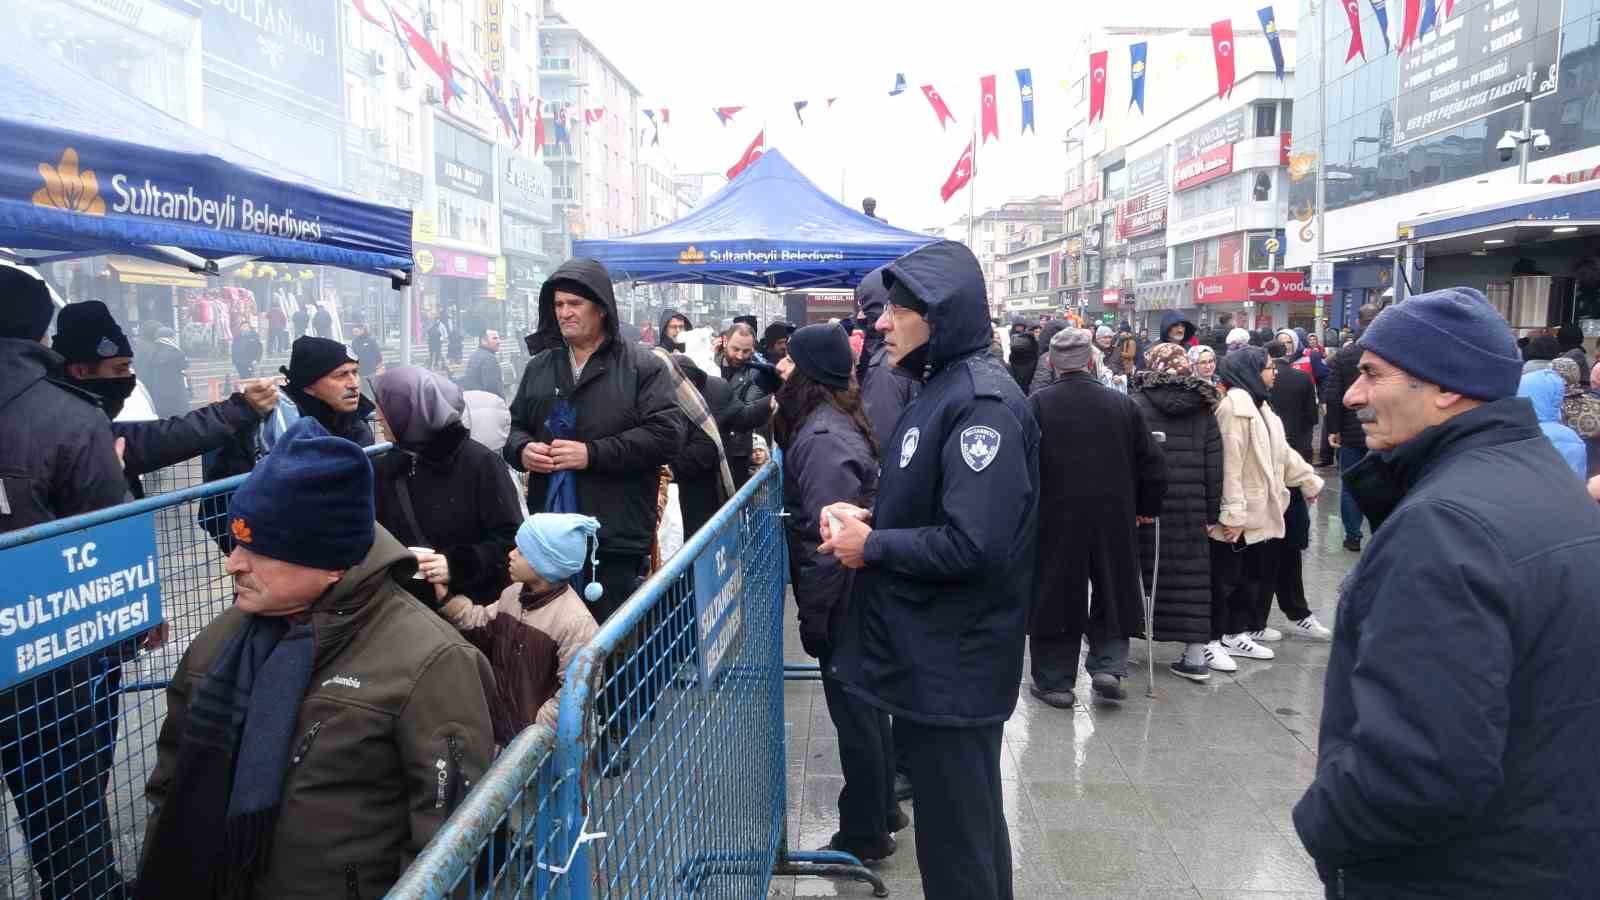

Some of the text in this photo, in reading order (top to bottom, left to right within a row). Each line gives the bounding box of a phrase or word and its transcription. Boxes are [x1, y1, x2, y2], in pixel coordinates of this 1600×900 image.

[209, 0, 291, 36] ULTAN
[111, 173, 321, 241] Sultanbeyli Belediyesi
[710, 250, 844, 264] Sultanbeyli Belediyesi
[1282, 280, 1308, 292] vod
[62, 542, 98, 573] T.C
[16, 593, 149, 674] BELEDİYESİ
